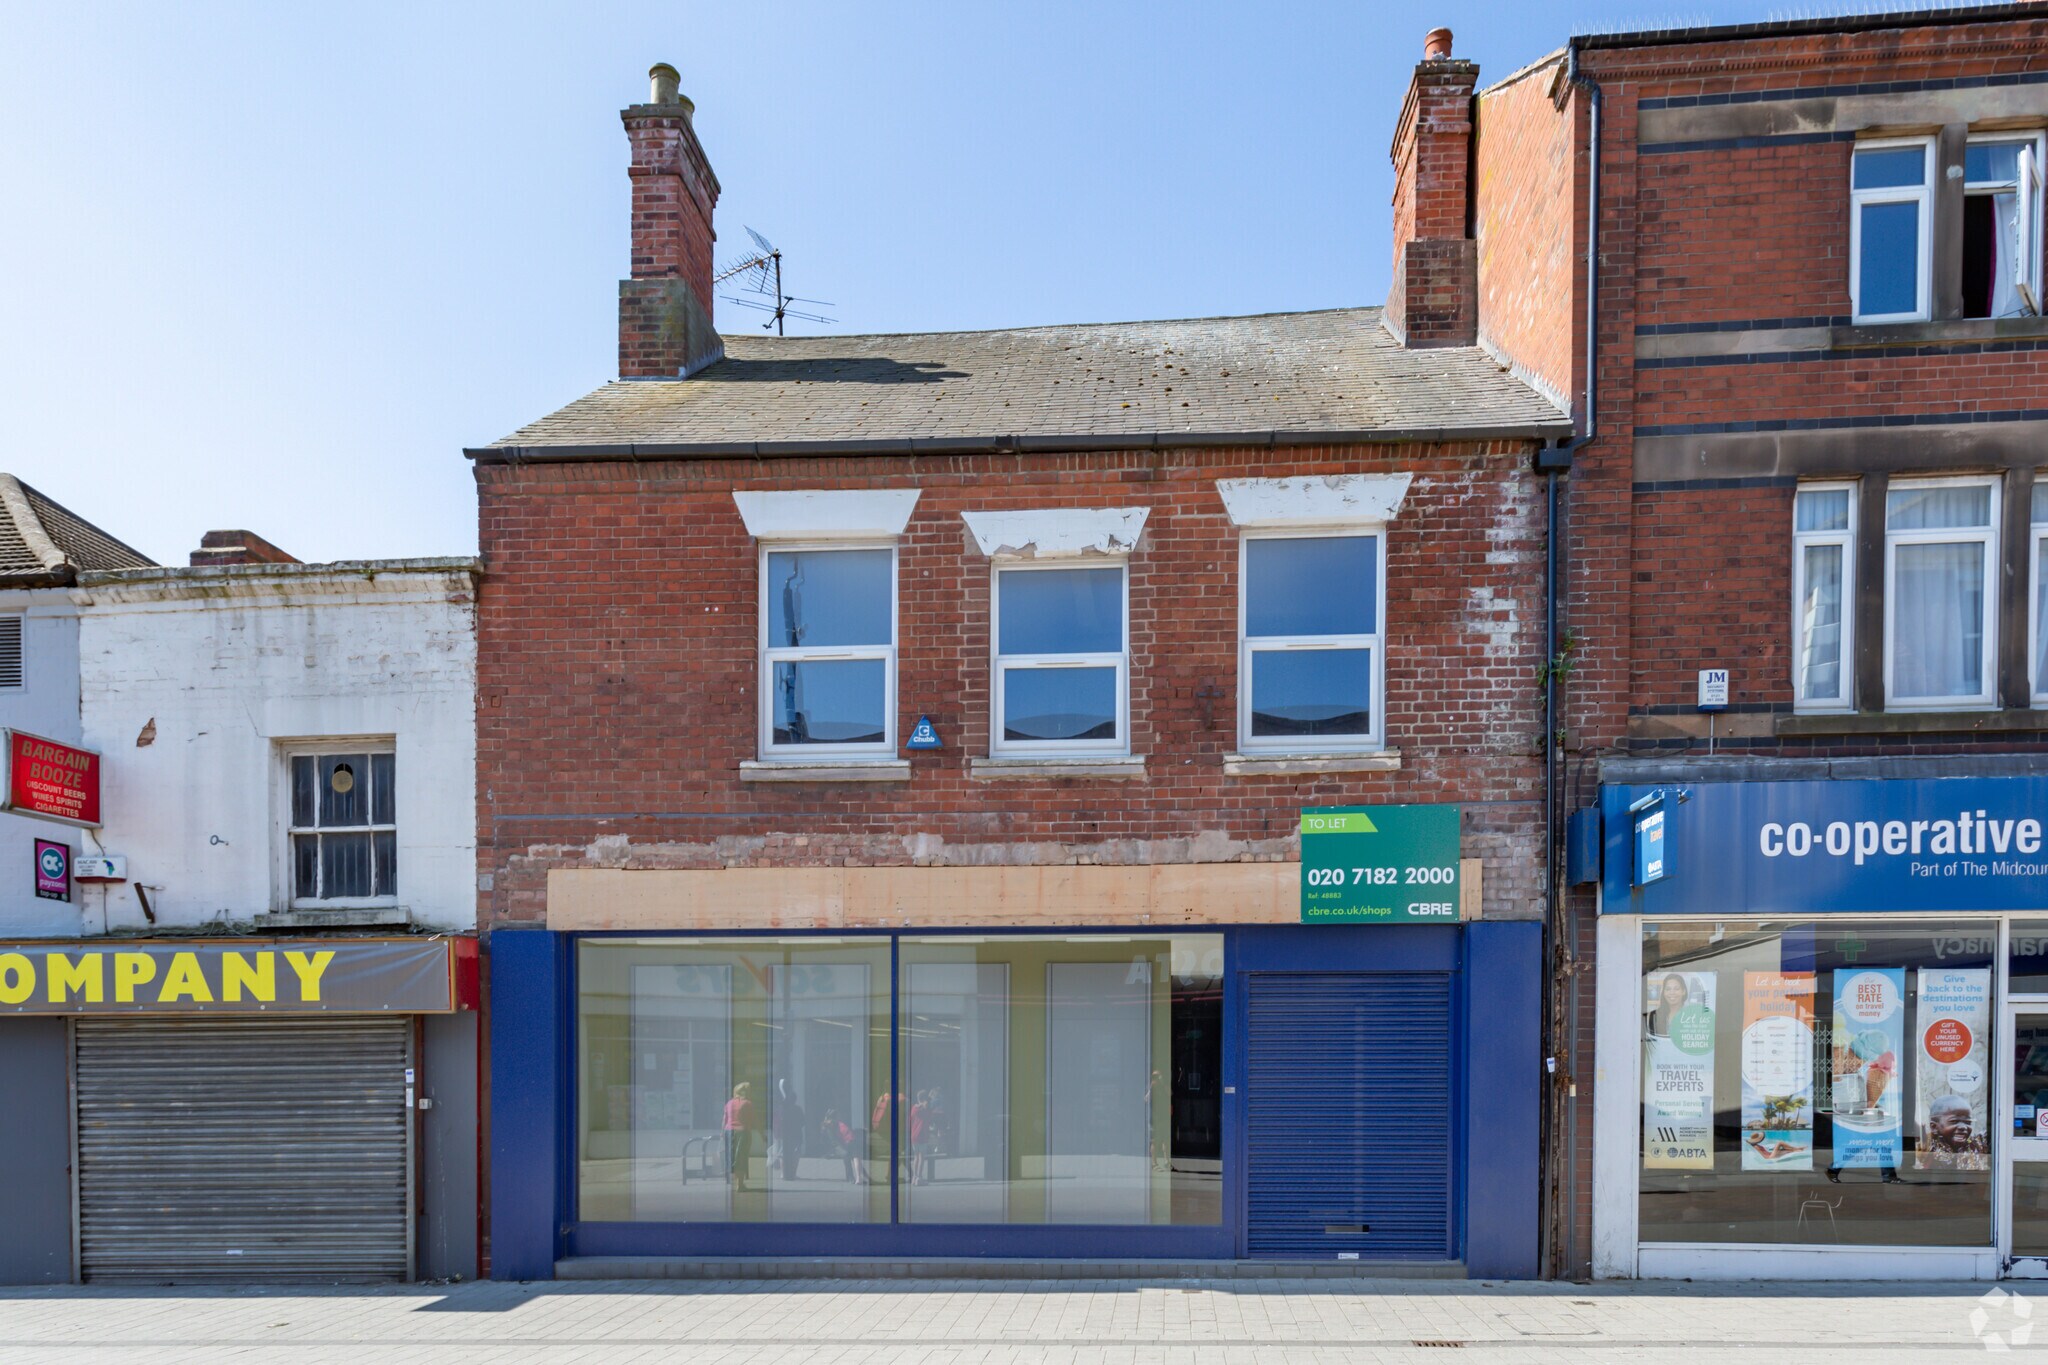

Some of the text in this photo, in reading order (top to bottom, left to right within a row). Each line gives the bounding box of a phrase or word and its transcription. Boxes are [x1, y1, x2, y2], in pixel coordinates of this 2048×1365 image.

[1706, 672, 1725, 684] JM
[21, 740, 90, 771] BARGAIN
[30, 762, 83, 788] BOOZE
[26, 780, 86, 800] DISCOUNT BEERS
[32, 791, 82, 809] WINES SPIRITS
[35, 801, 79, 818] CIGARETTES
[1308, 817, 1347, 829] TO LET
[1760, 809, 2042, 866] co-operative
[1911, 862, 1939, 877] Part
[1944, 861, 1957, 877] of
[1961, 861, 1988, 876] The
[1308, 867, 1455, 886] 020 7182 2000
[39, 878, 67, 889] payzone
[1308, 904, 1392, 917] cbre.co.uk/shops
[1407, 903, 1454, 915] CBRE
[1755, 976, 1769, 986] Let
[1784, 975, 1801, 986] book
[1943, 975, 1966, 983] Give
[1747, 988, 1809, 999] your perfect
[1858, 984, 1882, 993] BEST
[1858, 994, 1882, 1002] RATE
[1923, 994, 1983, 1002] destinations
[1760, 1002, 1796, 1013] holiday
[1933, 1005, 1951, 1013] you
[1680, 1012, 1711, 1024] Let us
[1681, 1033, 1710, 1041] HOLIDAY
[1660, 1070, 1701, 1080] TRAVEL
[1656, 1081, 1704, 1092] EXPERTS
[1678, 1110, 1701, 1118] Winning
[1678, 1148, 1707, 1158] ABTA
